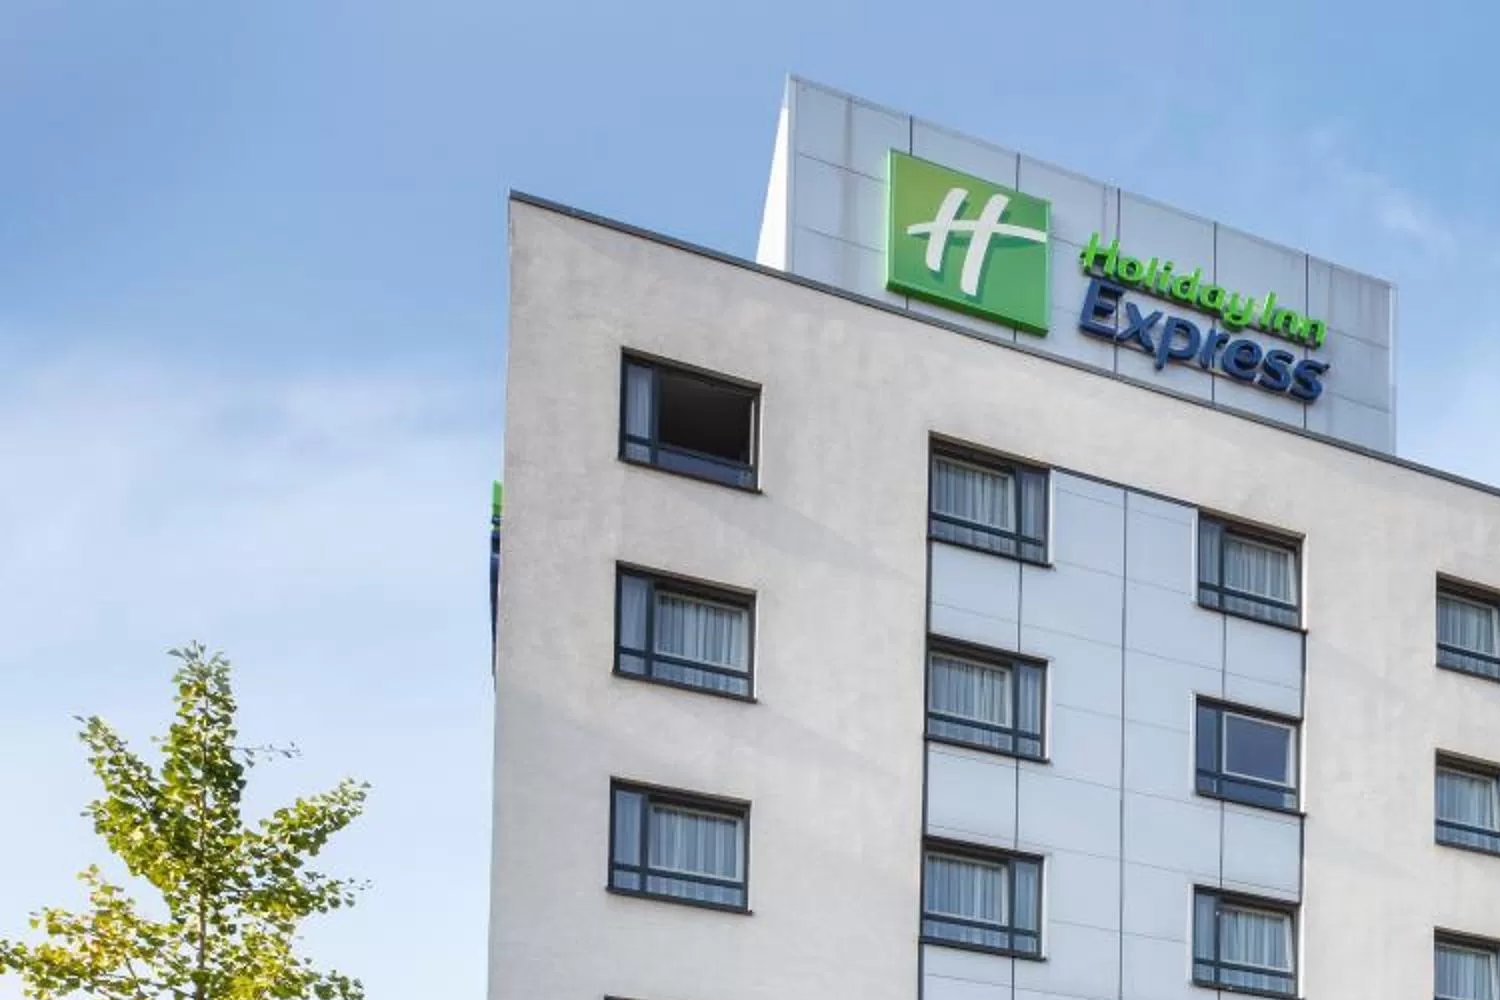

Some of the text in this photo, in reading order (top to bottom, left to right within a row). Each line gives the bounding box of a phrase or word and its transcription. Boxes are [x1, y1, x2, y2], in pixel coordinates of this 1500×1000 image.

[1079, 278, 1331, 404] Express
[1080, 232, 1327, 348] Holiday Inn
